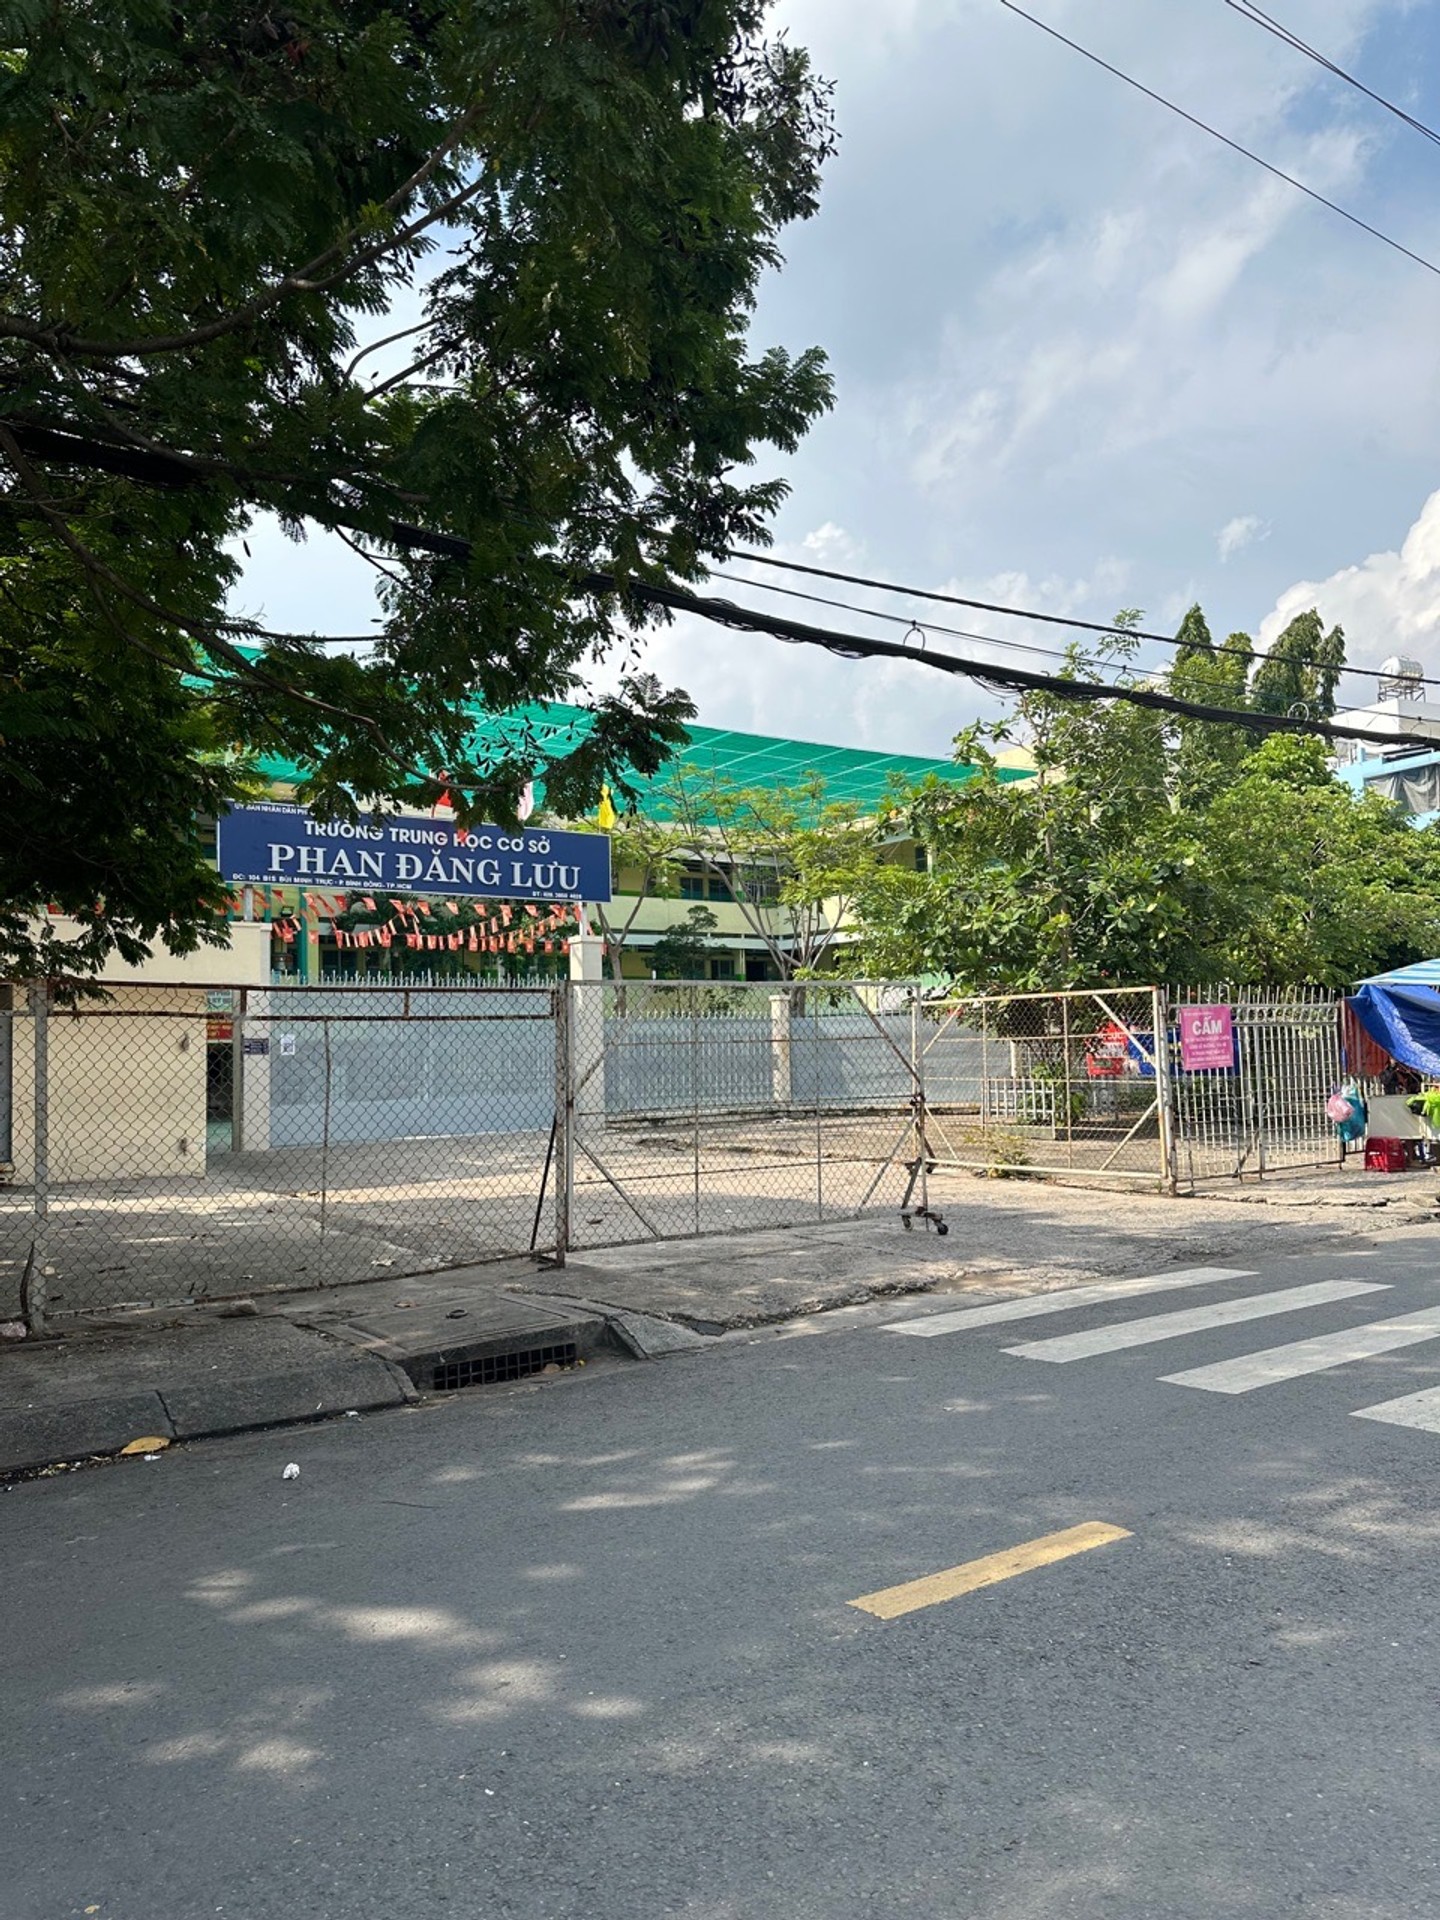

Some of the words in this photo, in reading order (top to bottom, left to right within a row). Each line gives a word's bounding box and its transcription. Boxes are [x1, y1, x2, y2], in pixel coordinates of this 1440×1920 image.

[304, 819, 383, 841] TRƯỜNG
[389, 827, 448, 846] TRUNG
[454, 833, 492, 852] HỌC
[497, 836, 524, 852] CƠ
[528, 836, 550, 854] SỞ
[267, 843, 386, 878] PHAN
[395, 848, 502, 886] ĐĂNG
[511, 861, 581, 890] LƯU
[1192, 1015, 1223, 1036] CẤM
